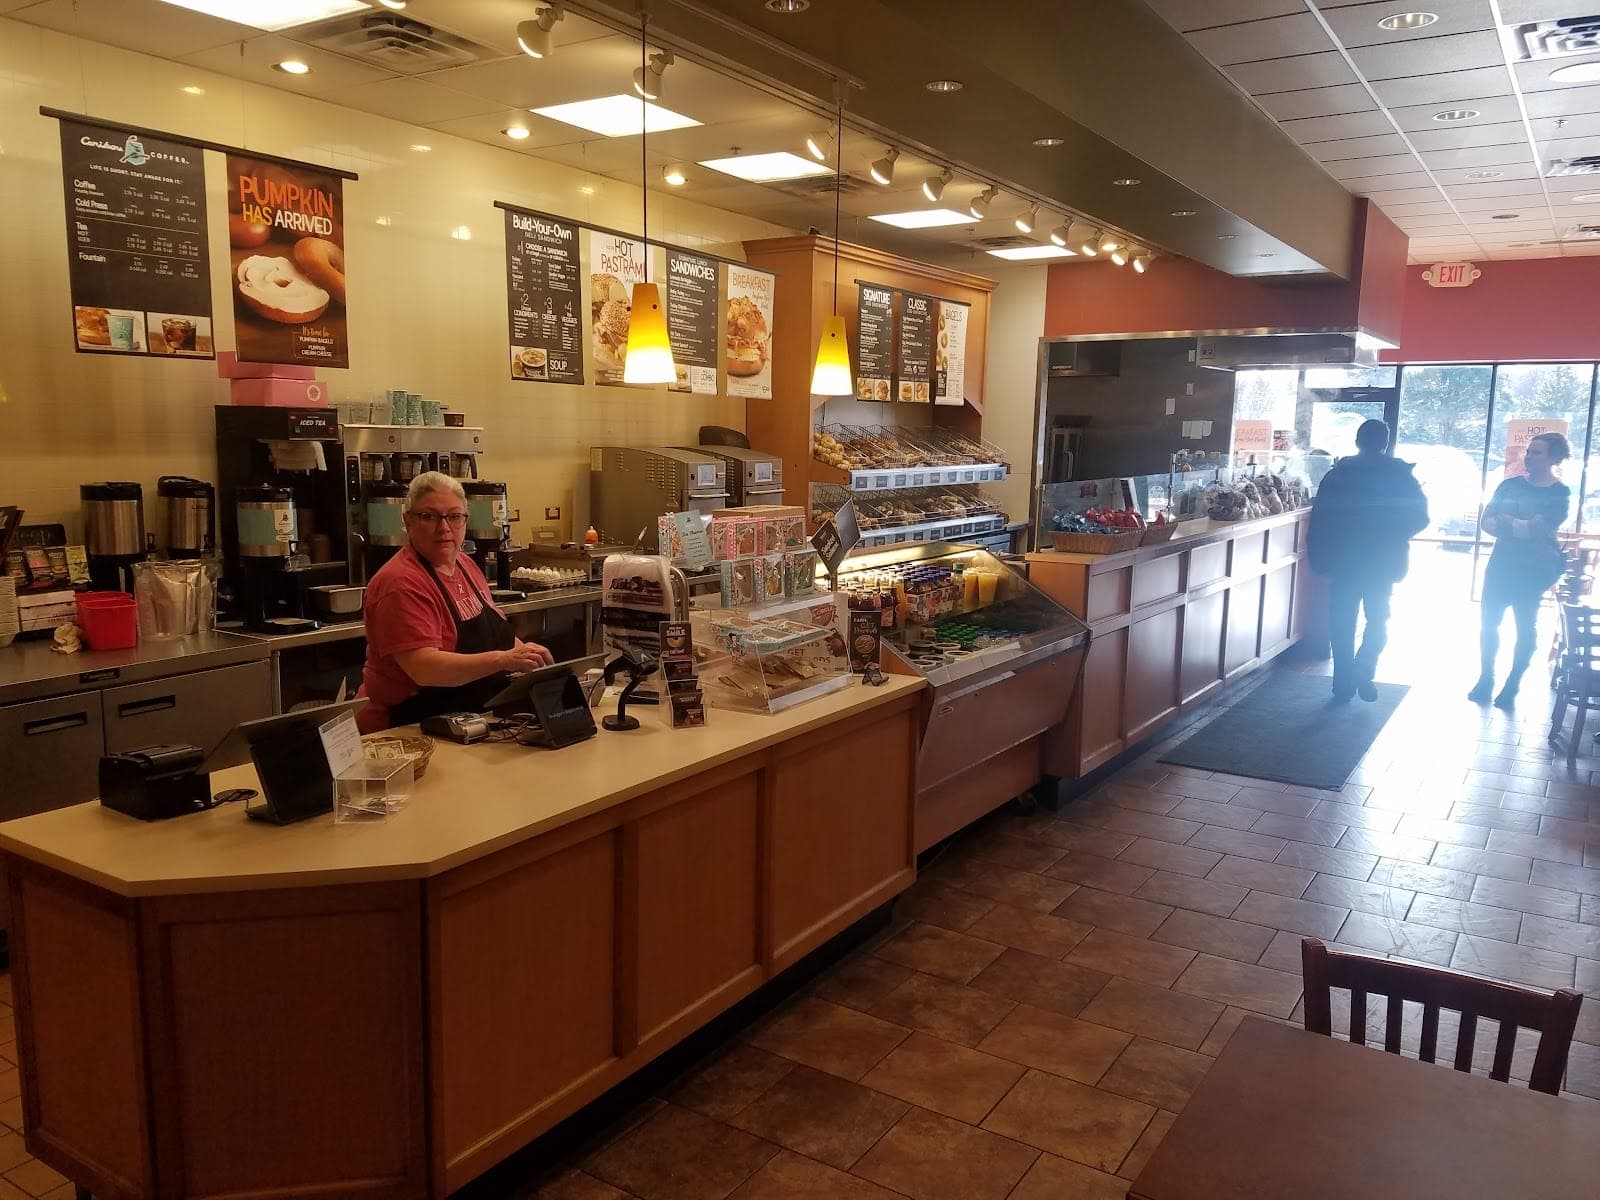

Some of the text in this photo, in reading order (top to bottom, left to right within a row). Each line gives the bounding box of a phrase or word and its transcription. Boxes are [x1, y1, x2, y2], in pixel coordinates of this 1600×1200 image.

[75, 198, 91, 207] Cold
[240, 175, 333, 218] PUMPKIN
[242, 203, 333, 236] HAS ARRIVED
[513, 214, 572, 241] Build-Your-Own
[614, 238, 634, 258] HOT
[79, 252, 106, 263] Fountain
[670, 258, 715, 281] SANDWICHES
[1440, 265, 1466, 283] EXIT
[732, 272, 771, 291] BREAKFAST
[549, 360, 568, 371] SOUP
[1527, 426, 1547, 435] HOT
[787, 648, 806, 656] GET
